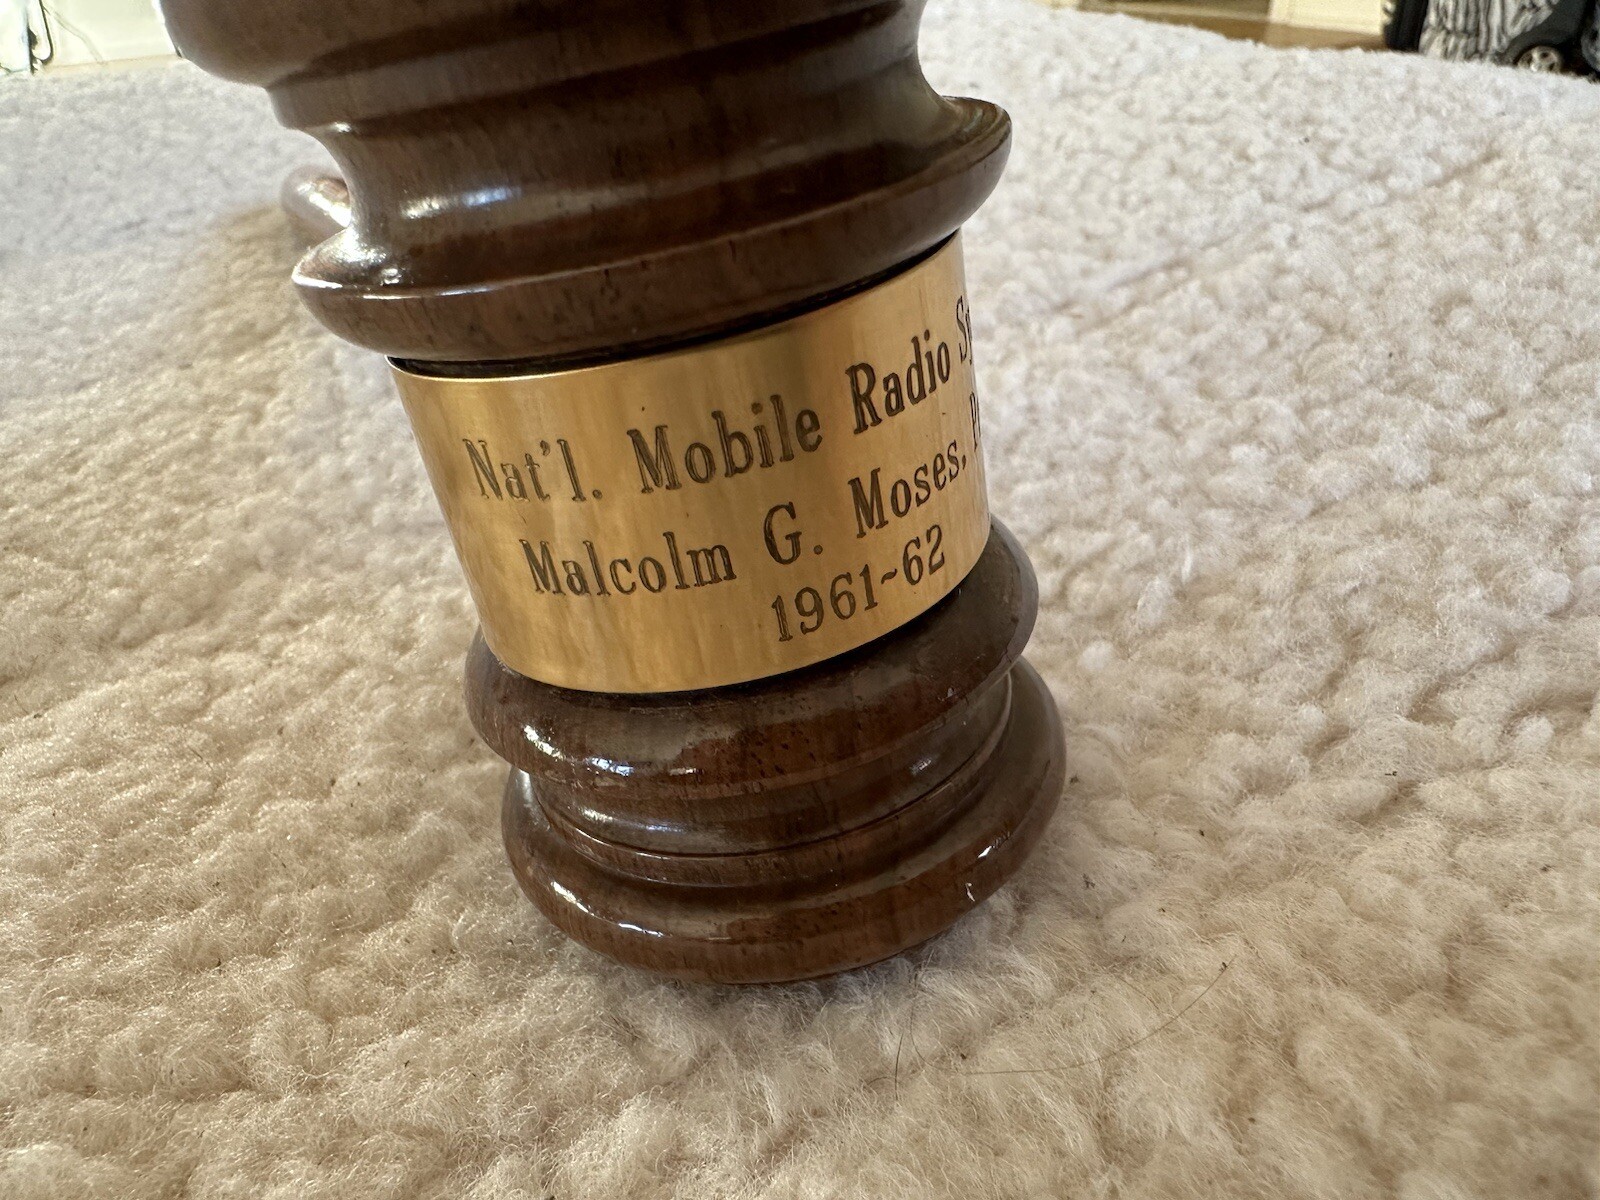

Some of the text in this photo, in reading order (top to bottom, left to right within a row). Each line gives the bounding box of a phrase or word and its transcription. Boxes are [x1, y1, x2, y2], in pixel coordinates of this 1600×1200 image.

[463, 438, 603, 502] Nat'l.
[626, 395, 823, 494] Mobile
[845, 329, 951, 435] Radio
[520, 532, 736, 598] Malcolm
[762, 501, 825, 565] G.
